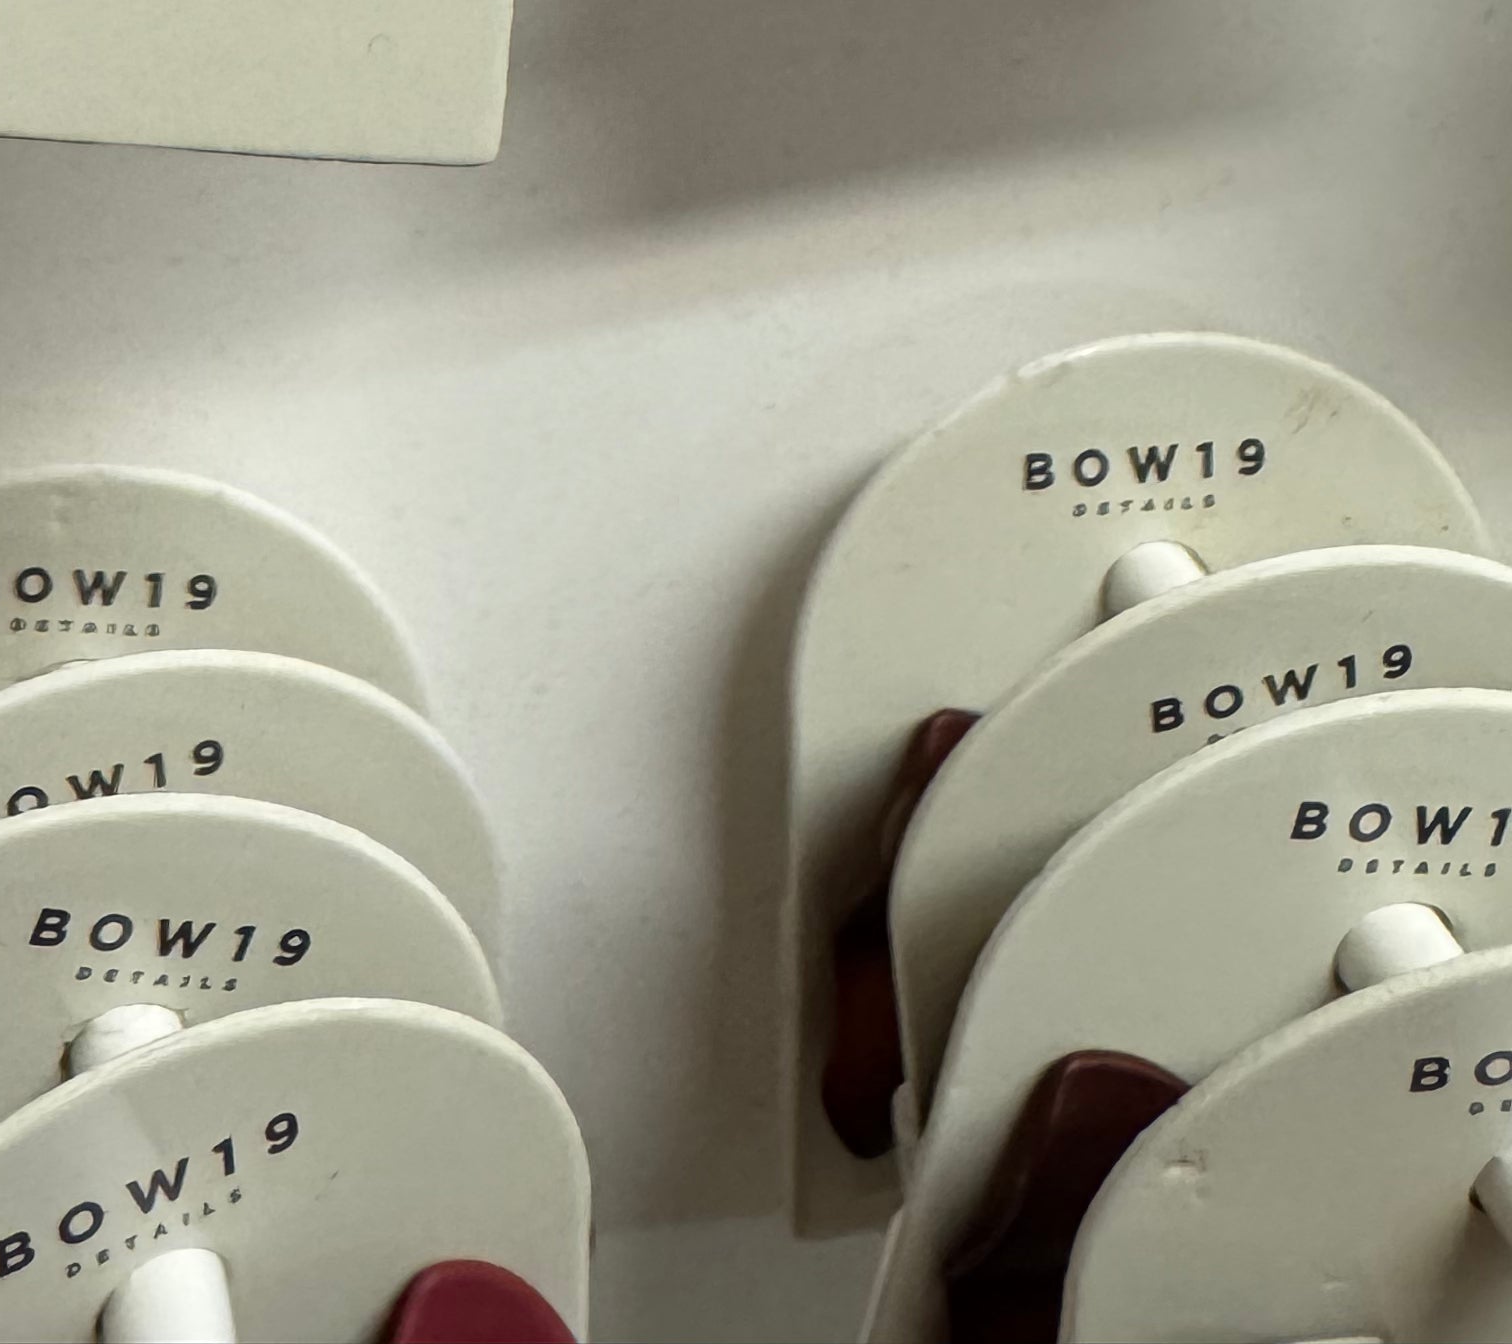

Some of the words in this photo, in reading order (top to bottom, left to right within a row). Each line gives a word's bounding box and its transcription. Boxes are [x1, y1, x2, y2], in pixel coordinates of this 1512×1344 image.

[1022, 438, 1266, 491] BOW19
[1150, 644, 1413, 733] BOW19
[1337, 857, 1497, 878] DETAILS
[29, 908, 312, 966] BOW19
[74, 967, 239, 992] DETAILS
[65, 1186, 243, 1279] DETAILS
